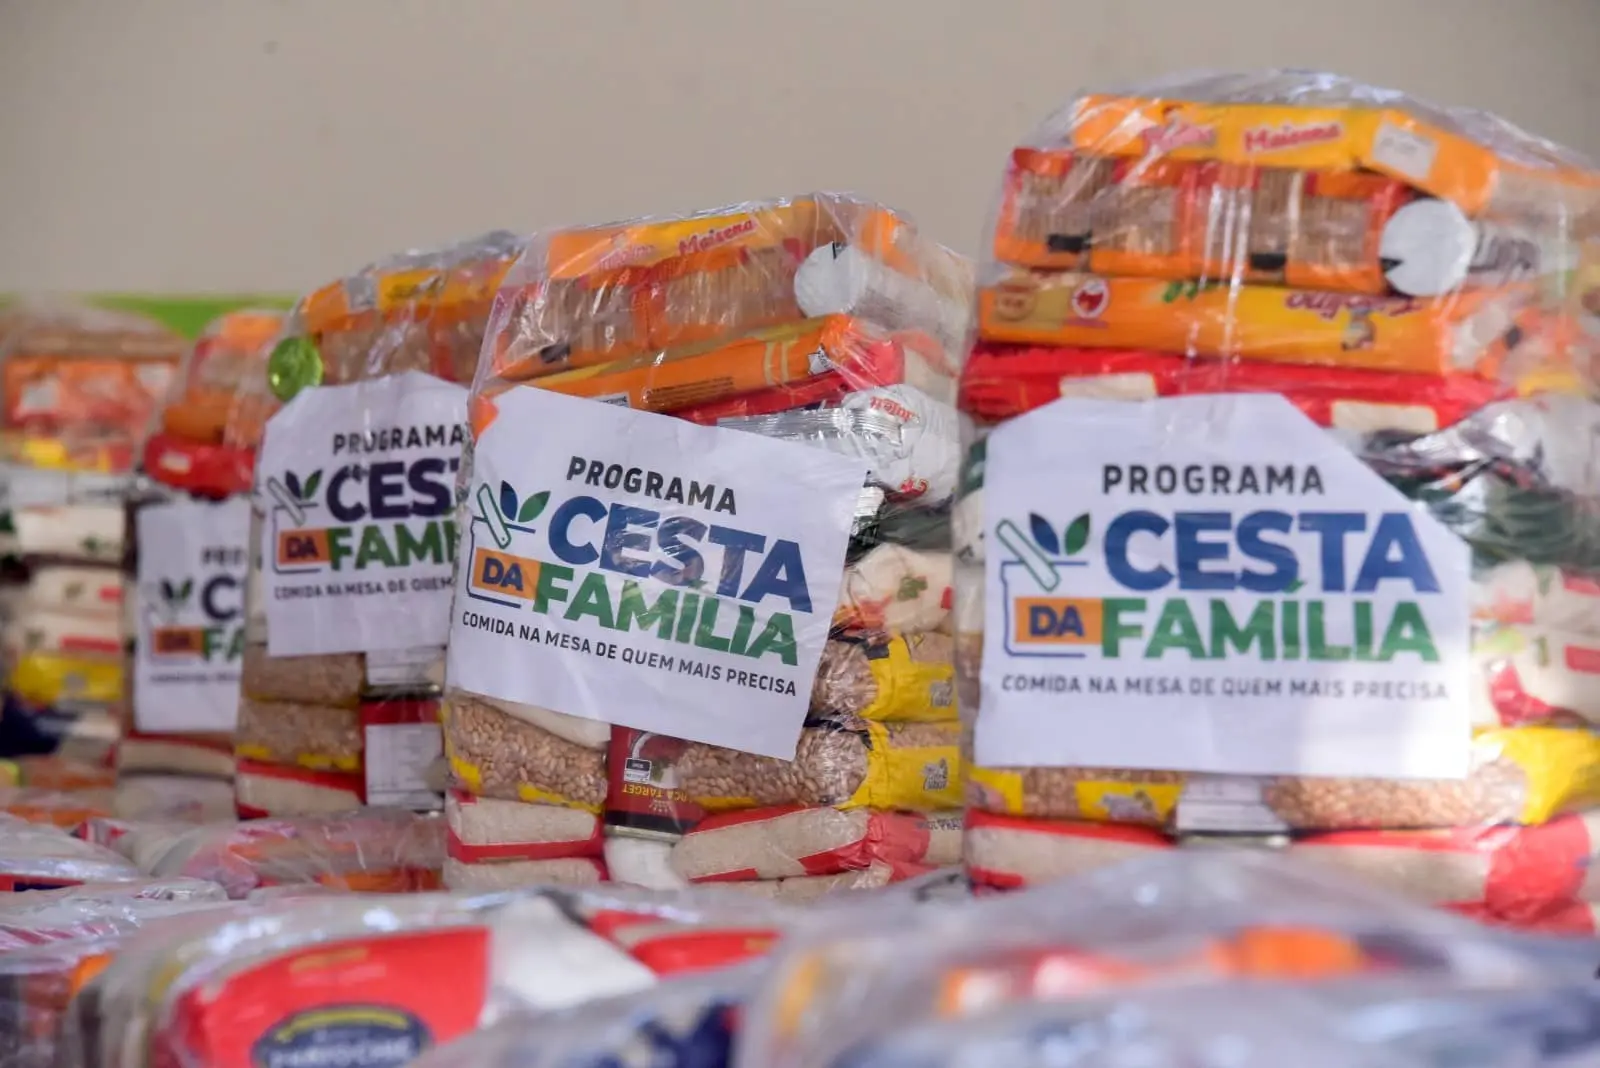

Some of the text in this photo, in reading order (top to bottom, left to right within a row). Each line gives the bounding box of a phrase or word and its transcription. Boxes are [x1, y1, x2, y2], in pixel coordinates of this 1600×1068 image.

[333, 424, 463, 455] PROGRAMA
[566, 455, 737, 515] PROGRAMA
[1102, 464, 1325, 495] PROGRAMA
[286, 536, 319, 559] DA
[548, 495, 813, 613] CESTA
[1104, 509, 1442, 594] CESTA
[345, 581, 383, 596] MESA
[388, 579, 408, 593] DE
[482, 556, 799, 666] DA FAMÍLIA
[1029, 580, 1441, 662] DA FAMÍLIA
[462, 611, 797, 697] COMIDA NA MESA DE QUEM MAIS PRECISA
[1002, 675, 1449, 700] COMIDA NA MESA DE QUEM MAIS PRECISA
[622, 783, 663, 798] TARGET
